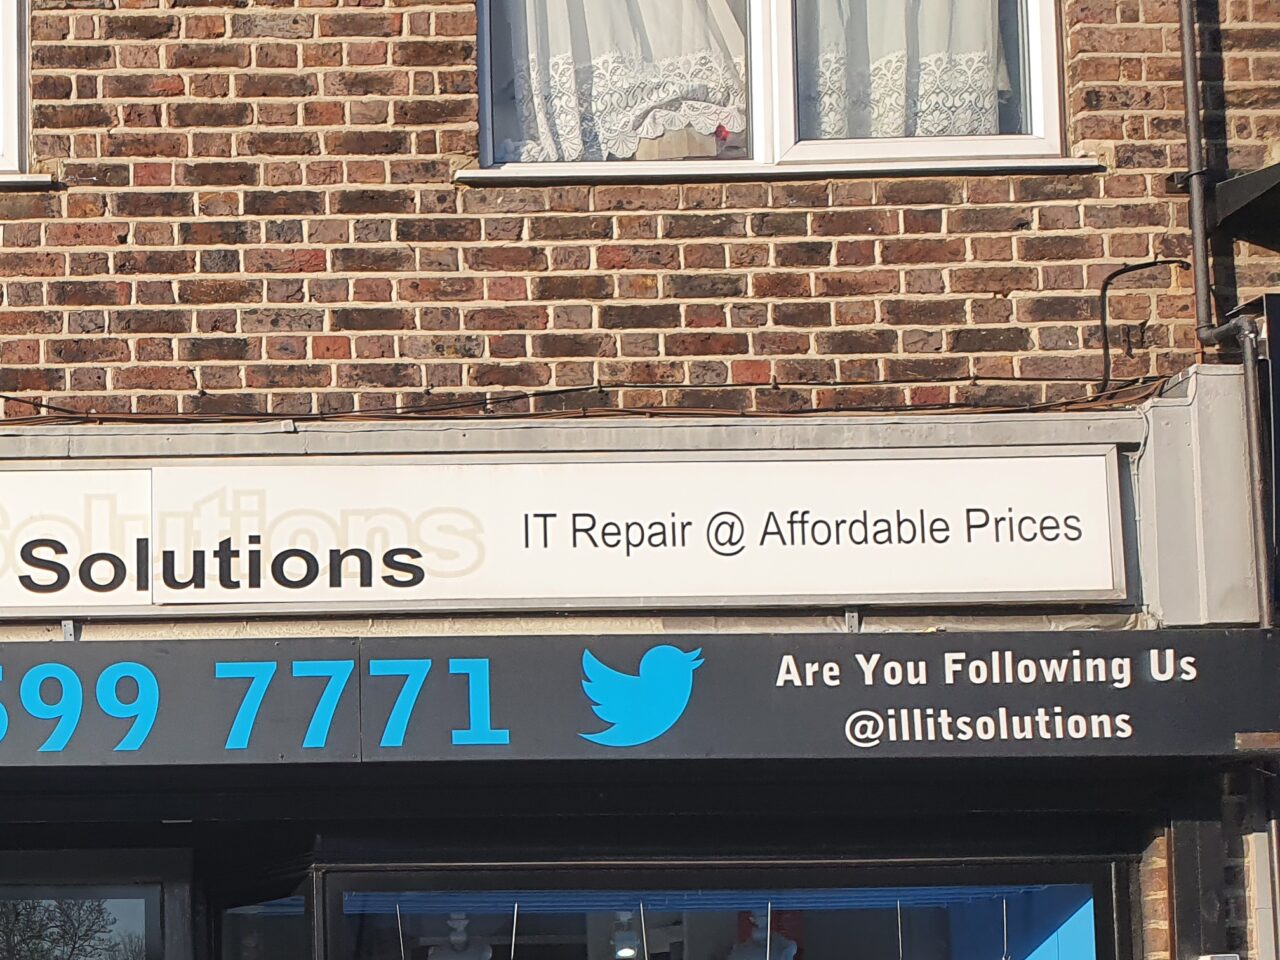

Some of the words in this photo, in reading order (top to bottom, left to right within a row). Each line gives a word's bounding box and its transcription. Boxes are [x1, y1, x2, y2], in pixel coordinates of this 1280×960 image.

[522, 513, 557, 549] IT
[571, 511, 692, 558] Repair
[706, 511, 747, 556] @
[759, 507, 951, 547] Affordable
[965, 505, 1084, 544] Prices
[18, 535, 426, 594] Solutions
[775, 654, 841, 688] Are
[855, 652, 926, 687] You
[944, 648, 1132, 688] Following
[1149, 646, 1198, 681] Us
[214, 658, 511, 752] 7771
[844, 706, 1133, 748] @illitsolutions
